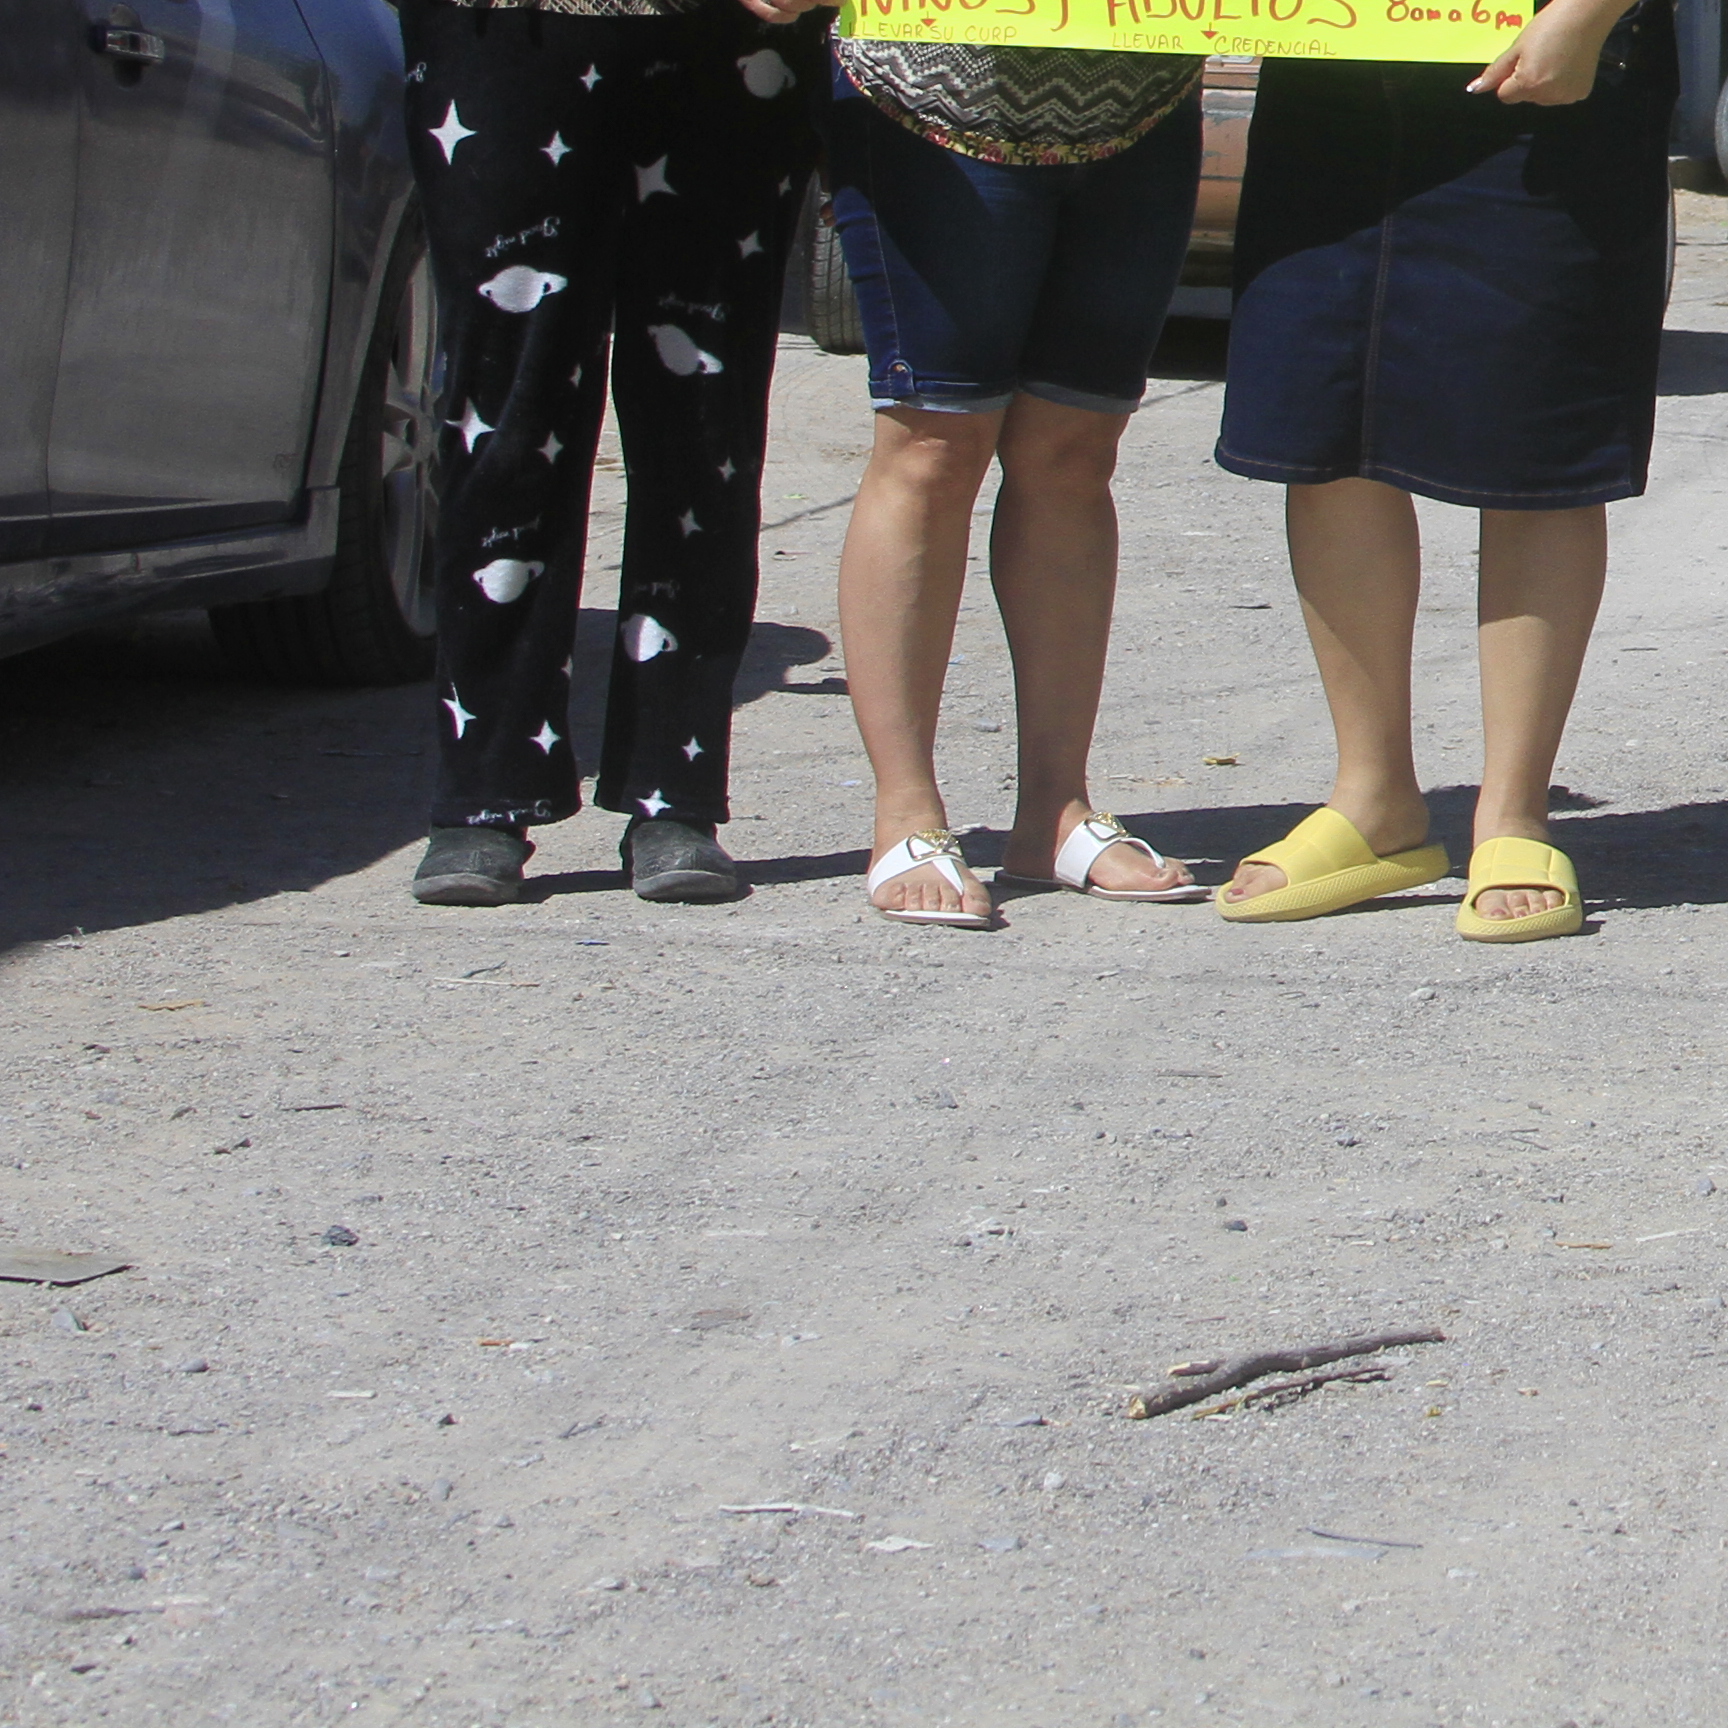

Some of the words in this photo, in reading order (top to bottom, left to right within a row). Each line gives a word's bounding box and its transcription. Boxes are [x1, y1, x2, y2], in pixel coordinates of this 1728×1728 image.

[850, 21, 924, 40] LLEVAR
[929, 25, 955, 42] SU
[963, 25, 1018, 45] CURP
[1111, 31, 1184, 51] LLEVAR
[1213, 35, 1338, 57] CREDENCIAL
